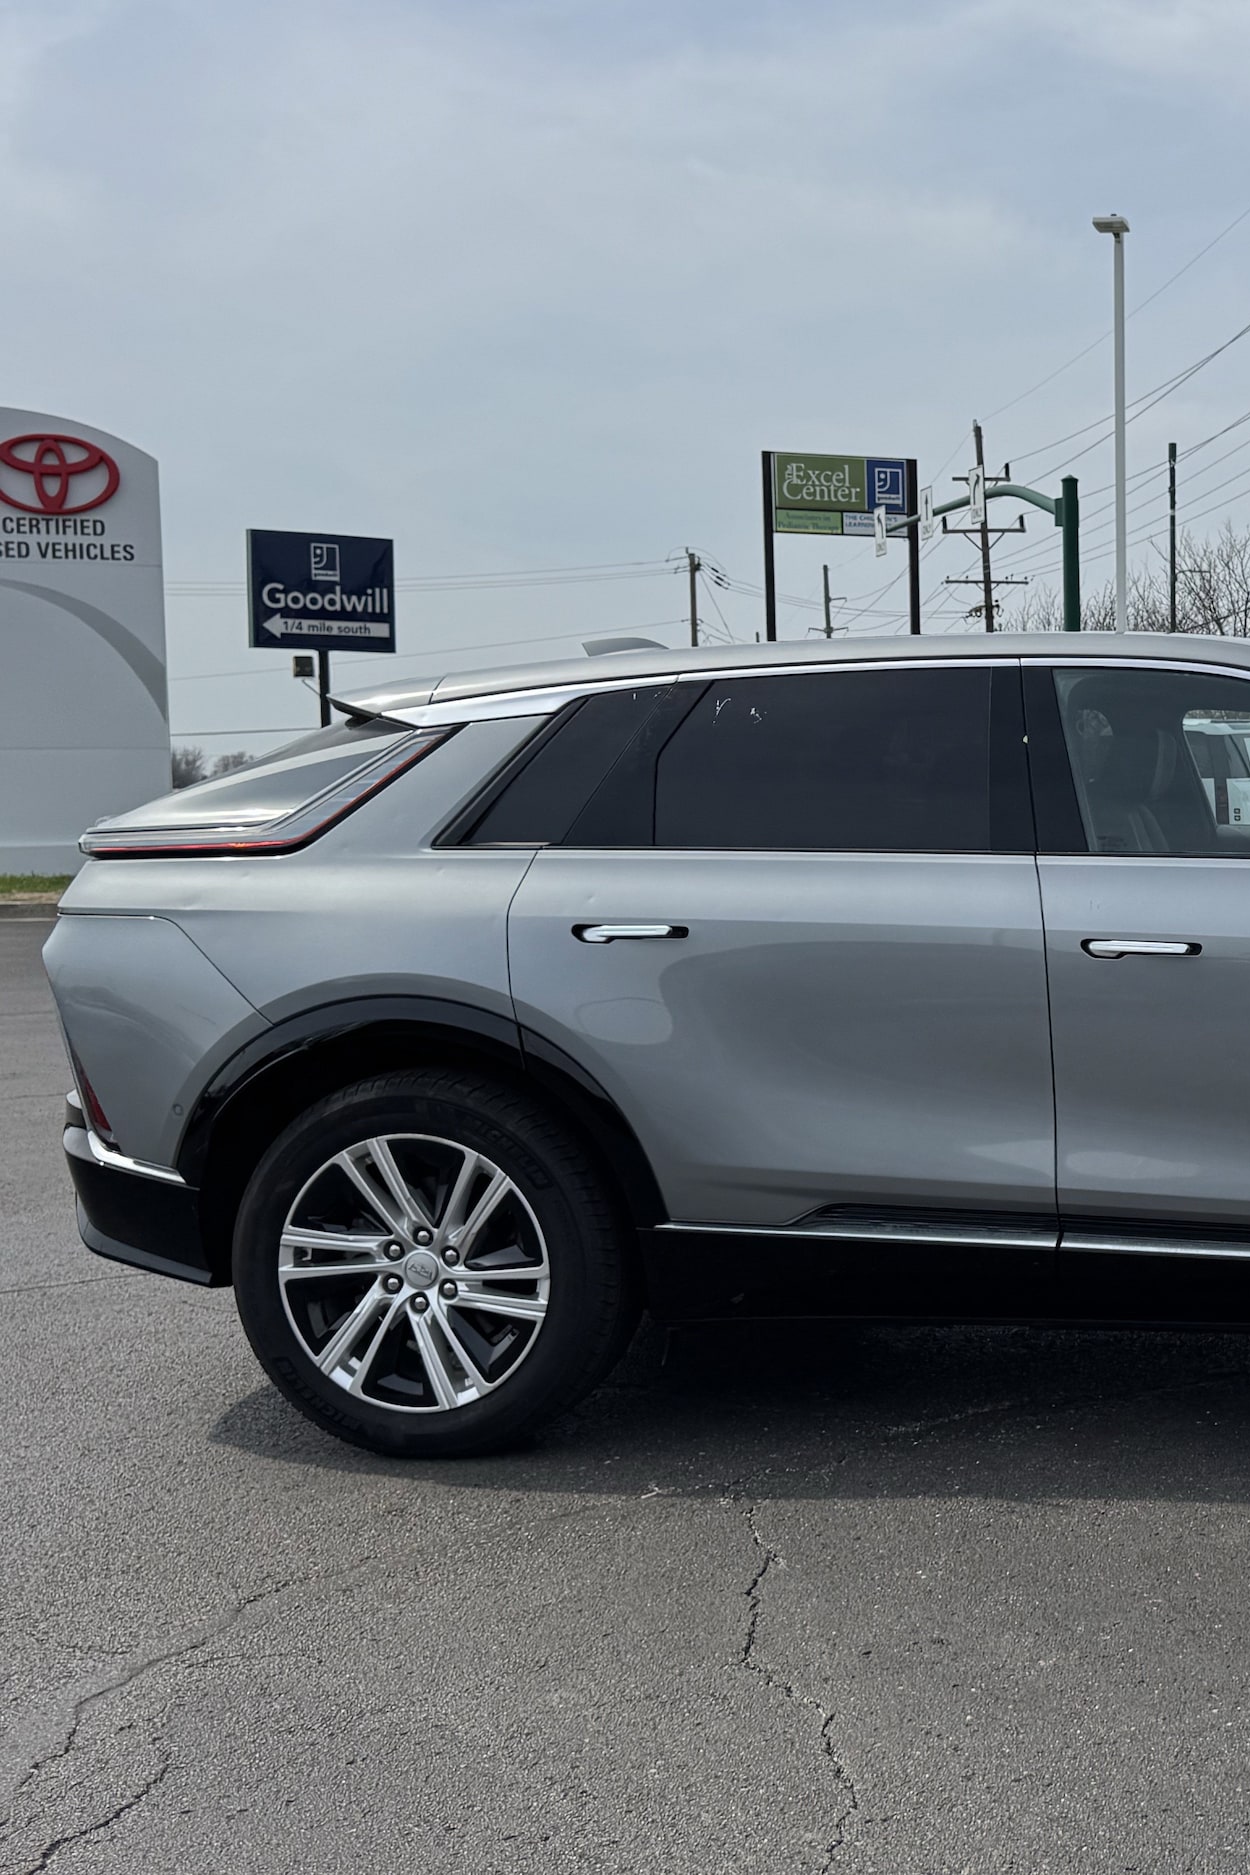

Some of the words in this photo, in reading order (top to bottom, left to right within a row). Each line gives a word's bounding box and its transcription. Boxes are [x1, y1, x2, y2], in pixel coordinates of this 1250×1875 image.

[790, 463, 850, 486] Excel
[782, 478, 861, 502] Center
[2, 516, 106, 537] CERTIFIED
[37, 541, 135, 562] VEHICLES
[261, 582, 389, 614] Goodwill
[283, 620, 303, 632] 1/4
[307, 622, 333, 633] mile
[337, 623, 371, 635] south
